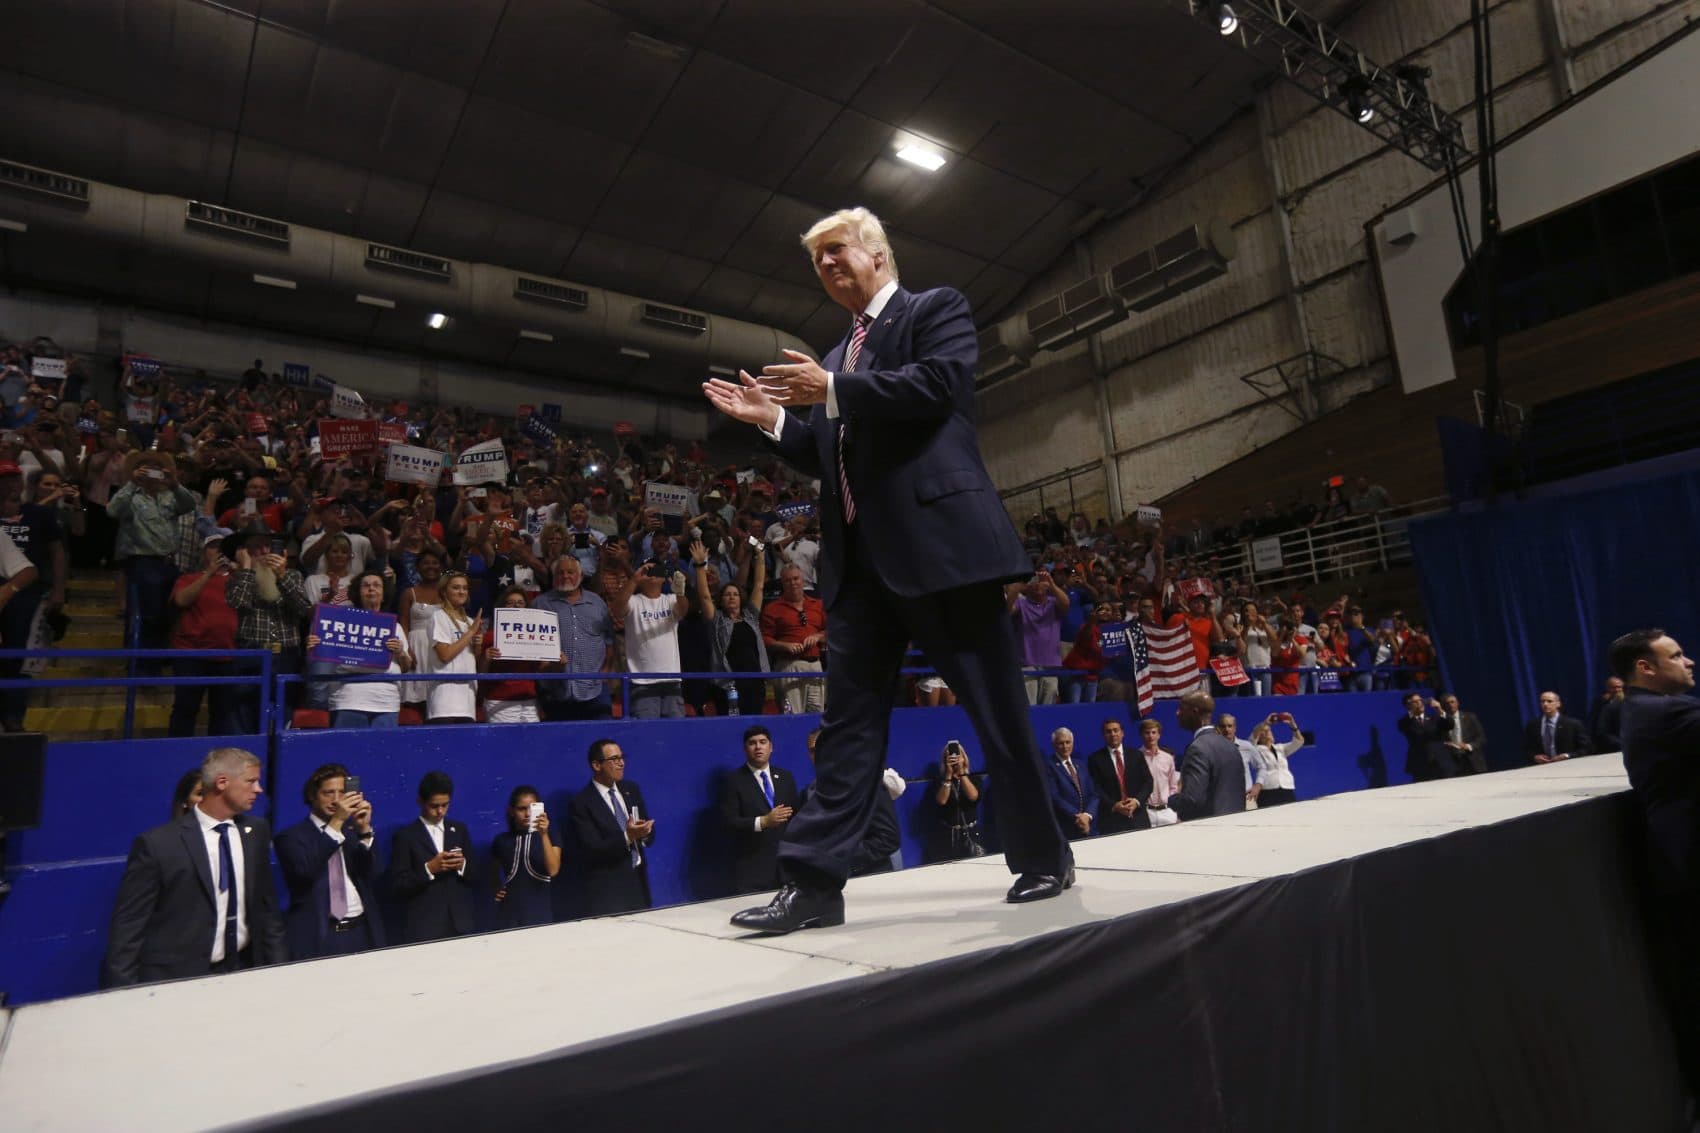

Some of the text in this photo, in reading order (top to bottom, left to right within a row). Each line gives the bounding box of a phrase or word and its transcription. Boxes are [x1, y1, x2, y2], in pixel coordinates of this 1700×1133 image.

[322, 431, 377, 444] AMERICA
[393, 454, 440, 467] TRUMP
[458, 451, 503, 464] TRUMP
[396, 463, 434, 472] PENCE
[650, 491, 686, 500] TRUMP
[642, 609, 672, 619] TRUMP
[320, 619, 391, 638] TRUMP
[500, 622, 557, 634] TRUMP
[325, 633, 382, 647] PENCE
[506, 633, 555, 641] PENCE
